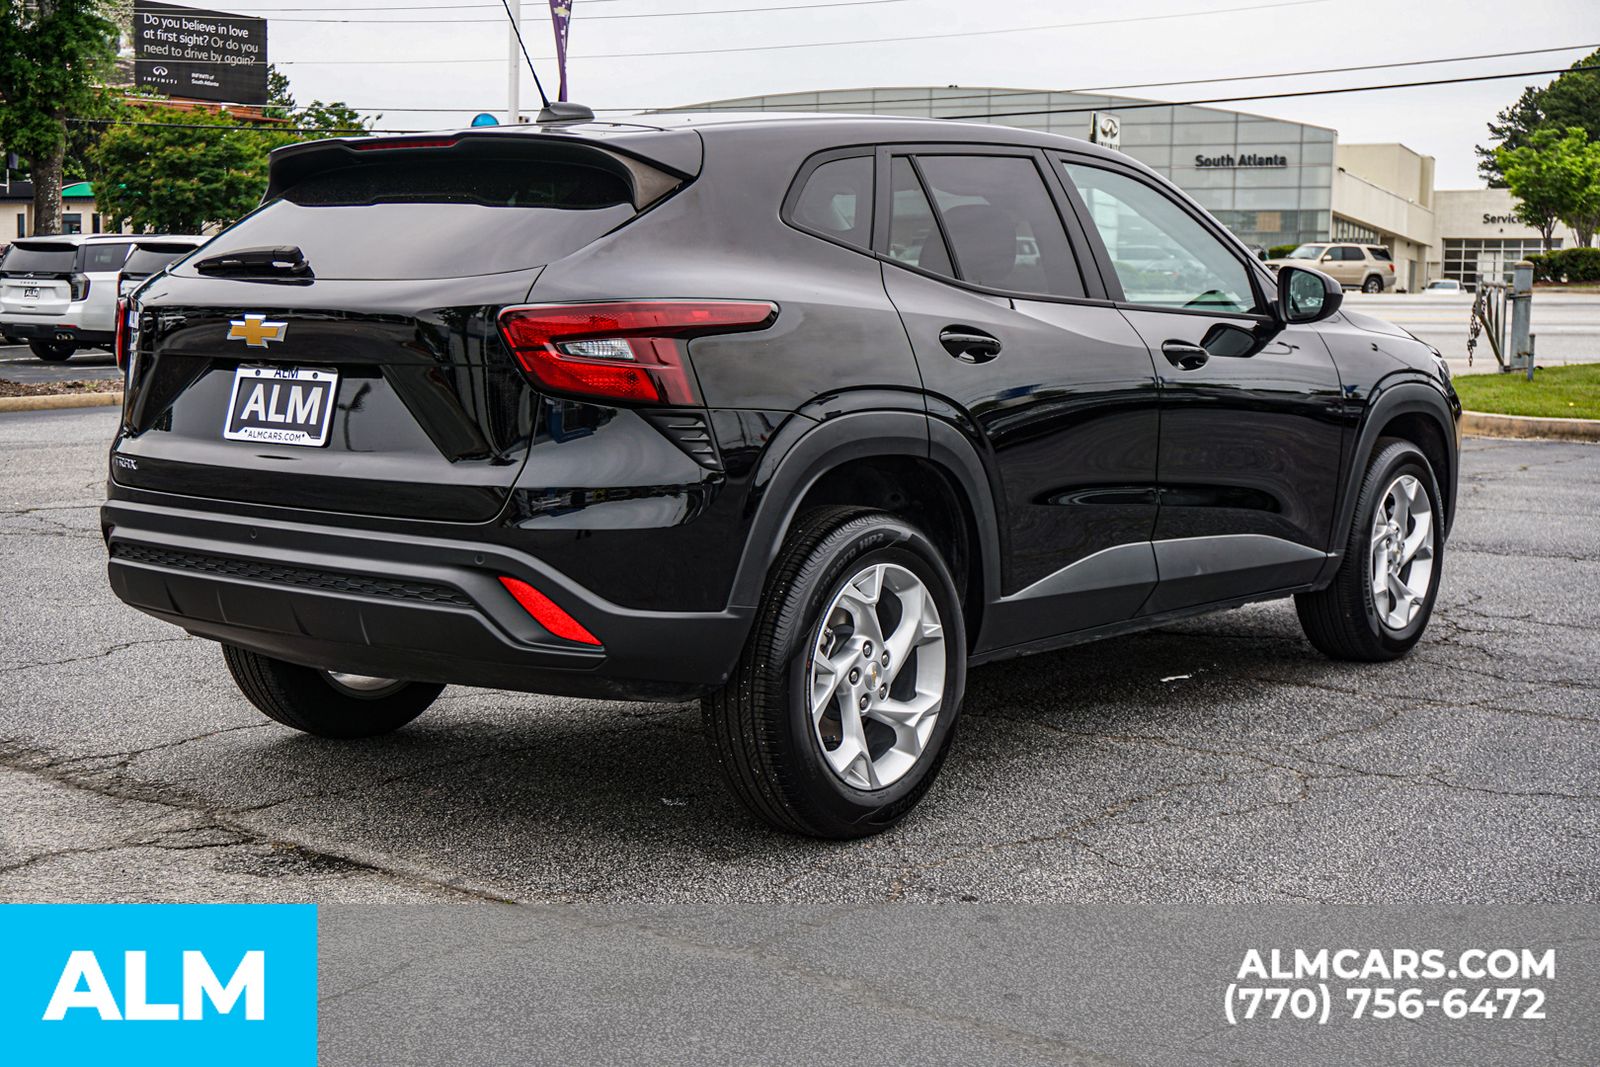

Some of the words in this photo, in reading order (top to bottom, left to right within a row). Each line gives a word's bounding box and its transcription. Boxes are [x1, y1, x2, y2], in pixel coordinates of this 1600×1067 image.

[143, 13, 159, 25] Do
[161, 18, 180, 29] you
[182, 18, 216, 33] believe
[218, 23, 227, 35] in
[229, 25, 249, 38] love
[143, 30, 155, 39] at
[157, 29, 178, 42] first
[180, 32, 209, 47] sight?
[211, 36, 224, 48] Or
[226, 39, 239, 50] do
[241, 44, 258, 54] you
[143, 44, 169, 55] need
[171, 47, 182, 57] to
[184, 48, 208, 60] drive
[210, 51, 222, 64] by
[224, 56, 256, 66] again?
[143, 76, 178, 84] INFINITI
[1195, 154, 1234, 167] South
[1238, 153, 1287, 167] Atlanta
[274, 367, 300, 379] ALM
[240, 383, 323, 425] ALM
[248, 430, 301, 442] ALMCARS.COM
